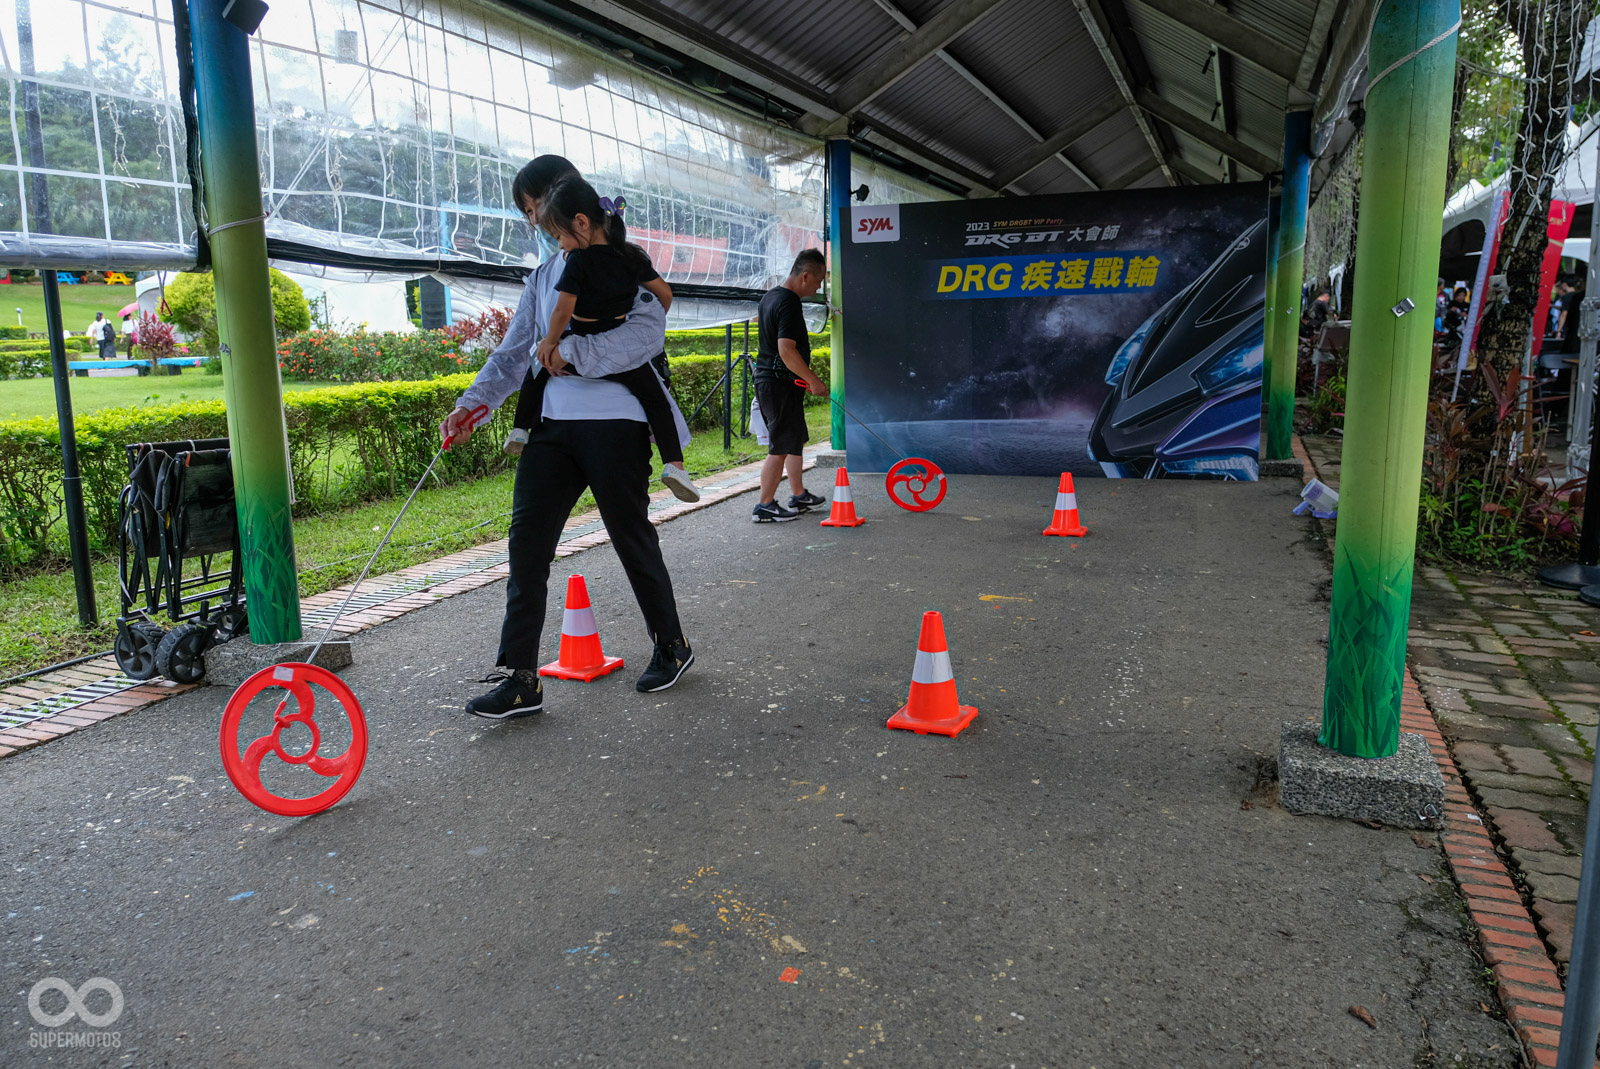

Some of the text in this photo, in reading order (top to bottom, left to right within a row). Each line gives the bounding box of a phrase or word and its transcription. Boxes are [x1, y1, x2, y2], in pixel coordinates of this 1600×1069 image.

[858, 217, 894, 235] SYM
[966, 222, 990, 231] 2023
[993, 220, 1008, 228] SYM
[1009, 219, 1032, 227] DRGBT
[965, 225, 1121, 249] DRG BT 大會師
[937, 255, 1161, 293] DRG 疾速戰輪
